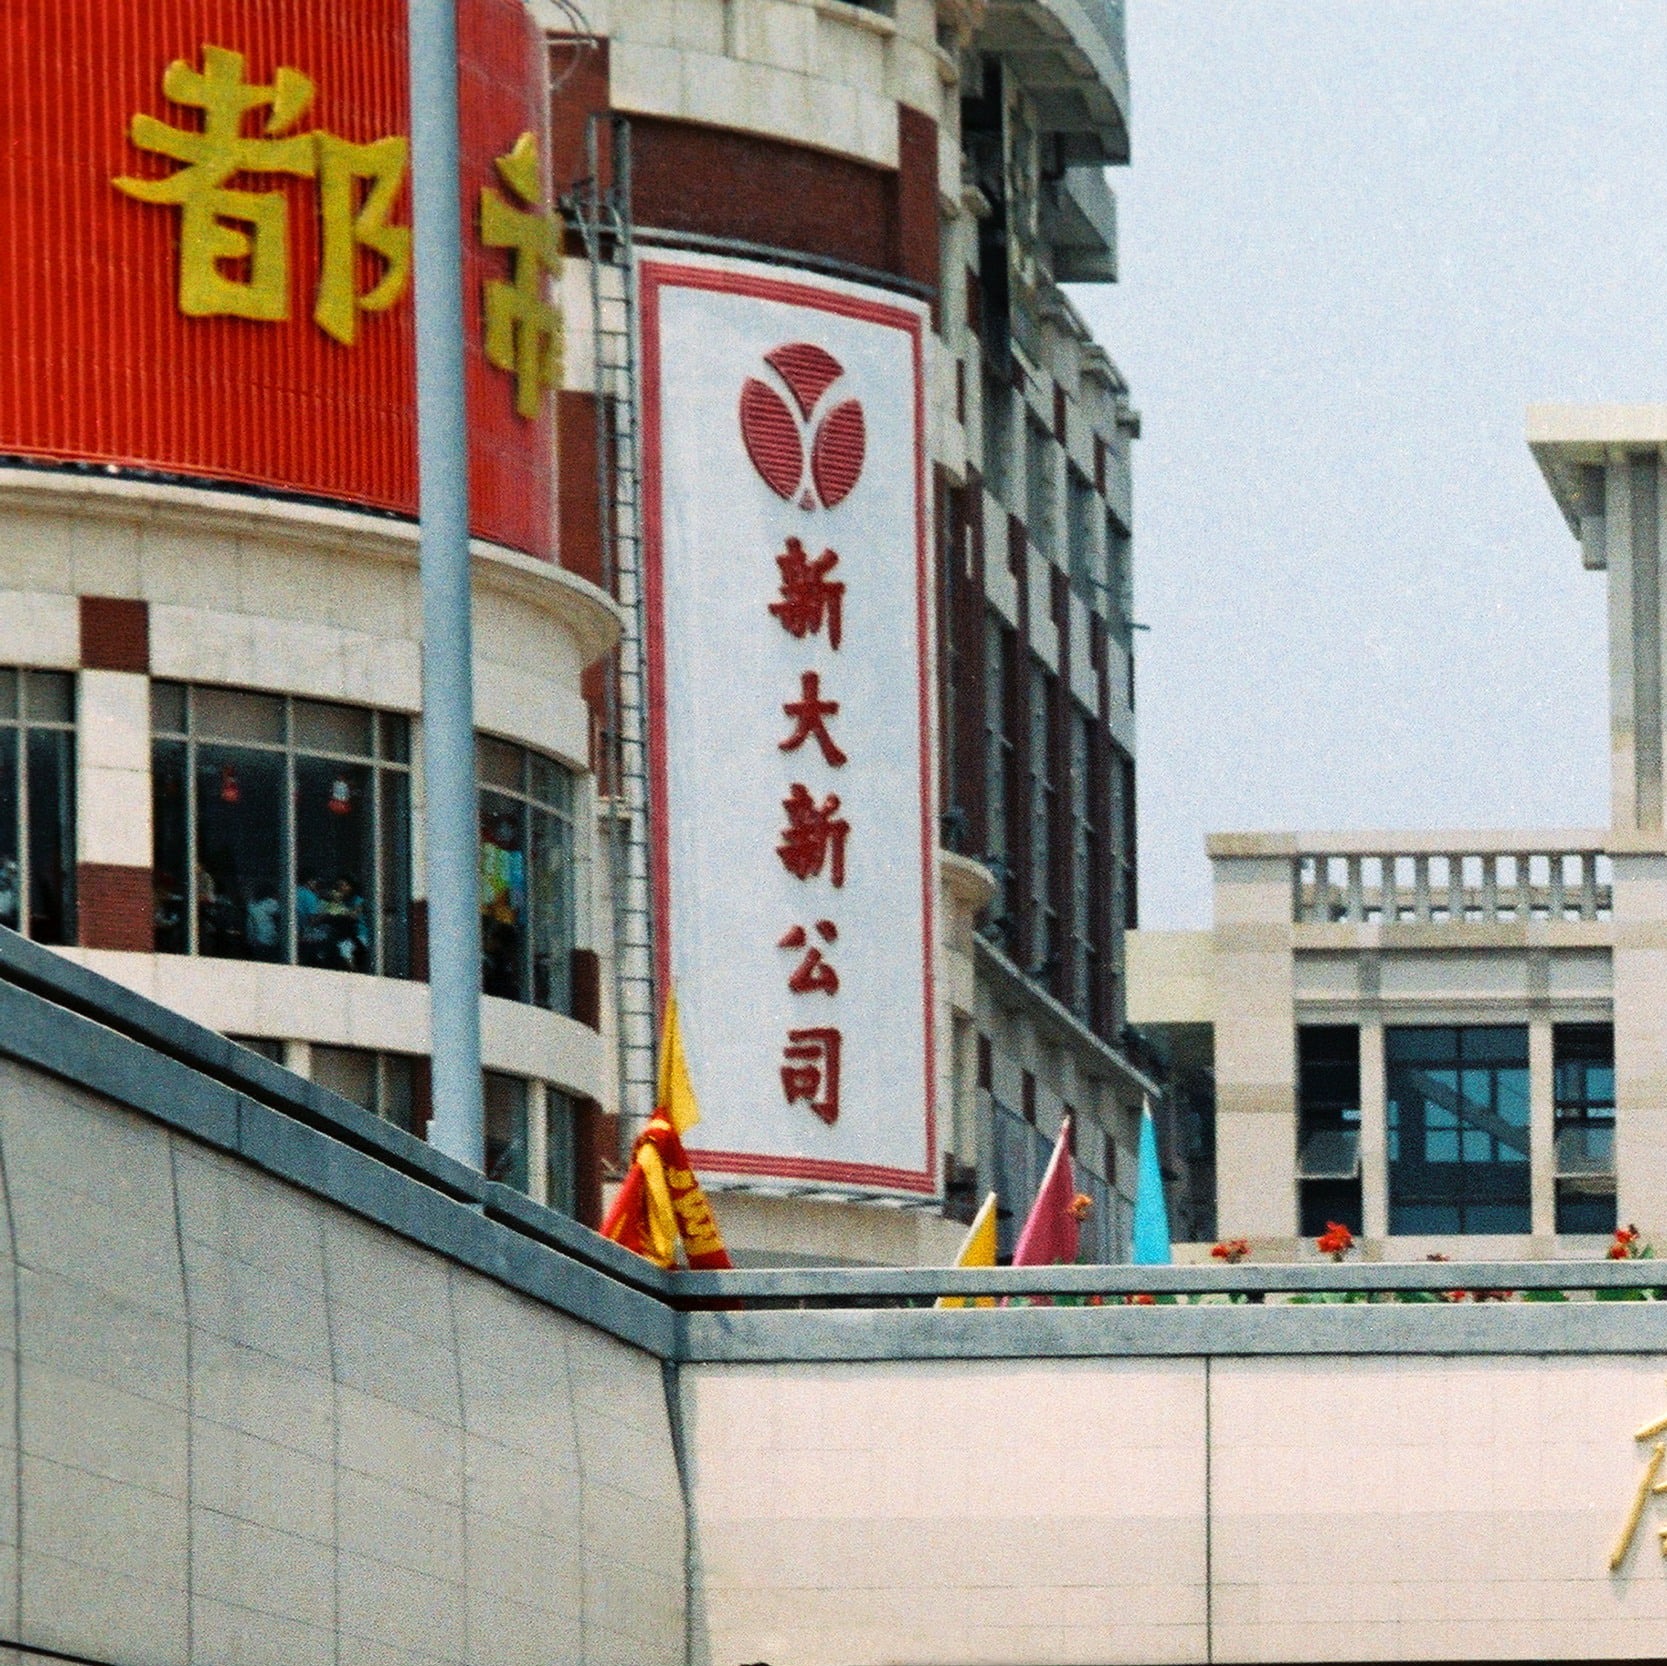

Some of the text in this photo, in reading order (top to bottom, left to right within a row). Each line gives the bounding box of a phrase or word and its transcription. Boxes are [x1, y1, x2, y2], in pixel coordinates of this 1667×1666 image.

[768, 537, 850, 1124] 新大新公司
